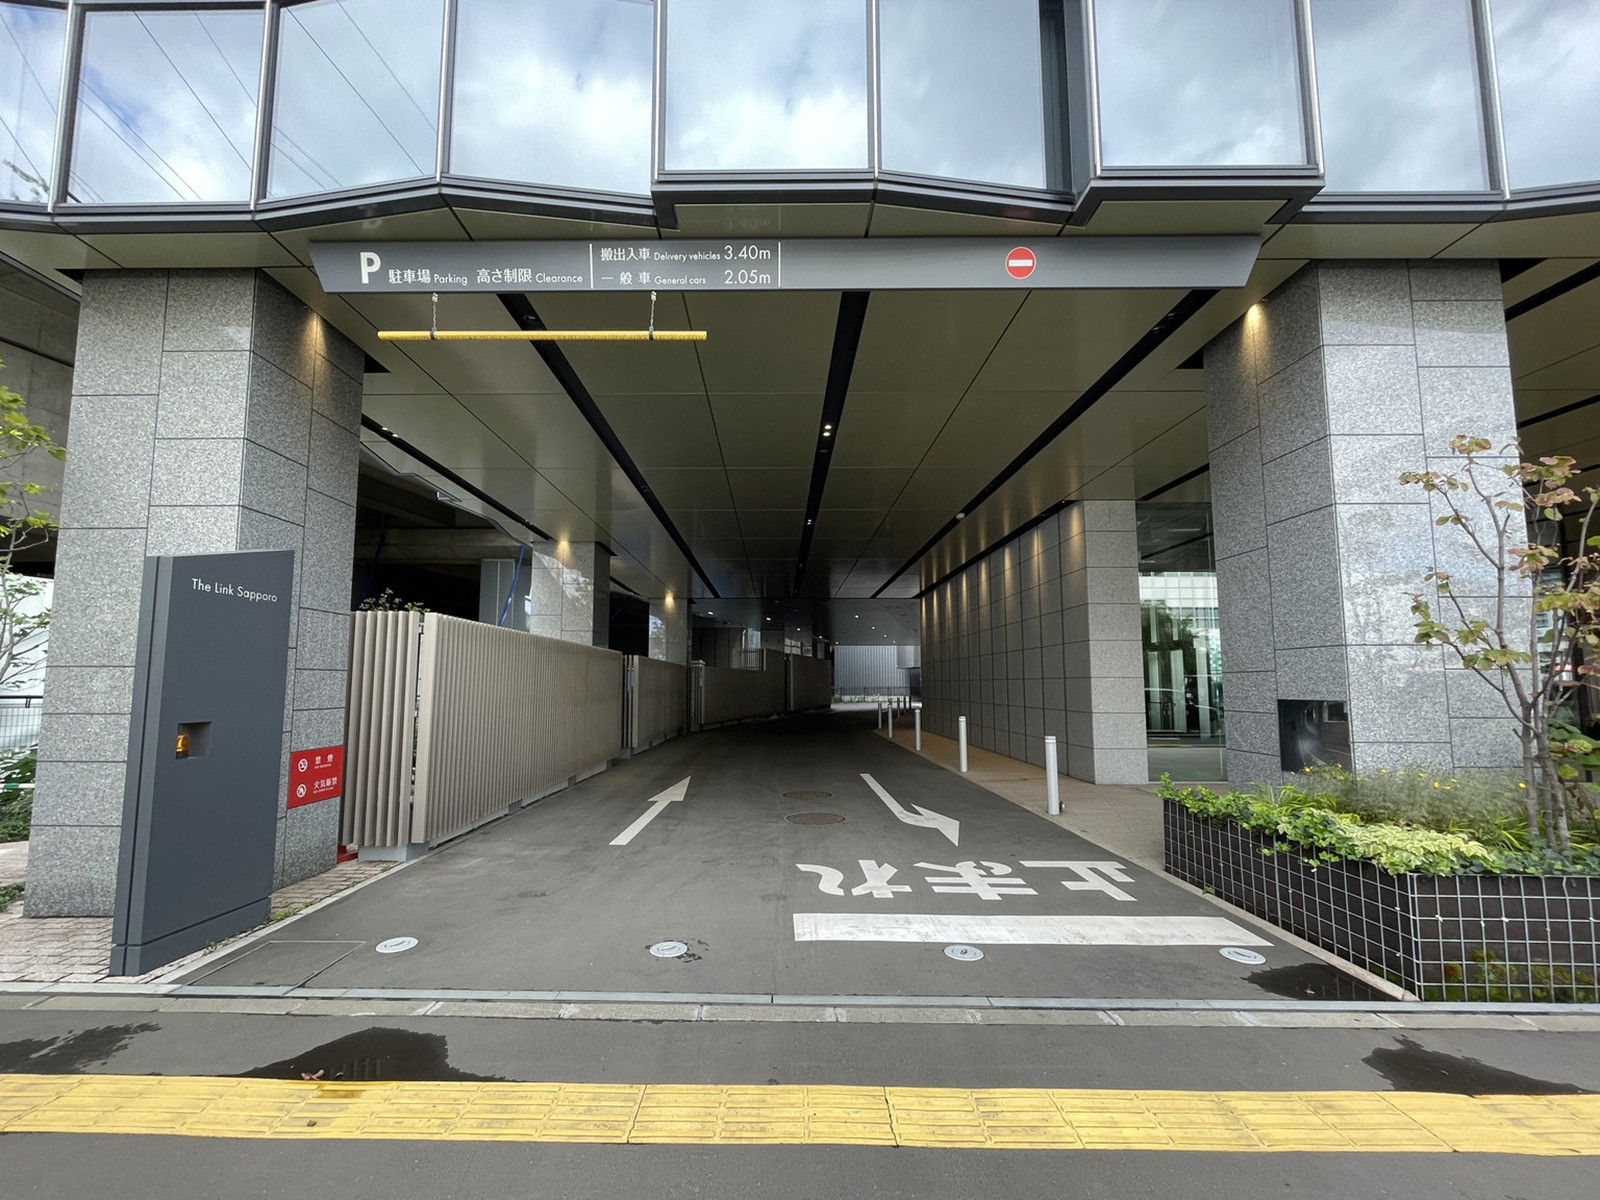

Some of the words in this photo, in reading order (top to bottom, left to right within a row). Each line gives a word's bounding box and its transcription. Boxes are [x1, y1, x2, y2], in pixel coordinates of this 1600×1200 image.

[600, 247, 651, 261] 搬出入車
[654, 251, 687, 262] Delivery
[689, 251, 721, 260] vehicles
[724, 245, 771, 260] 3.40m
[360, 251, 381, 284] P
[388, 268, 431, 284] 駐車場
[433, 273, 468, 286] Parking
[476, 268, 533, 284] 高さ制限
[535, 272, 583, 283] Clearance
[654, 275, 688, 285] General
[724, 269, 771, 284] 2.05m
[192, 578, 211, 592] The
[214, 582, 234, 596] Link
[237, 585, 278, 602] Sapporo
[795, 860, 1137, 901] 止まれ
